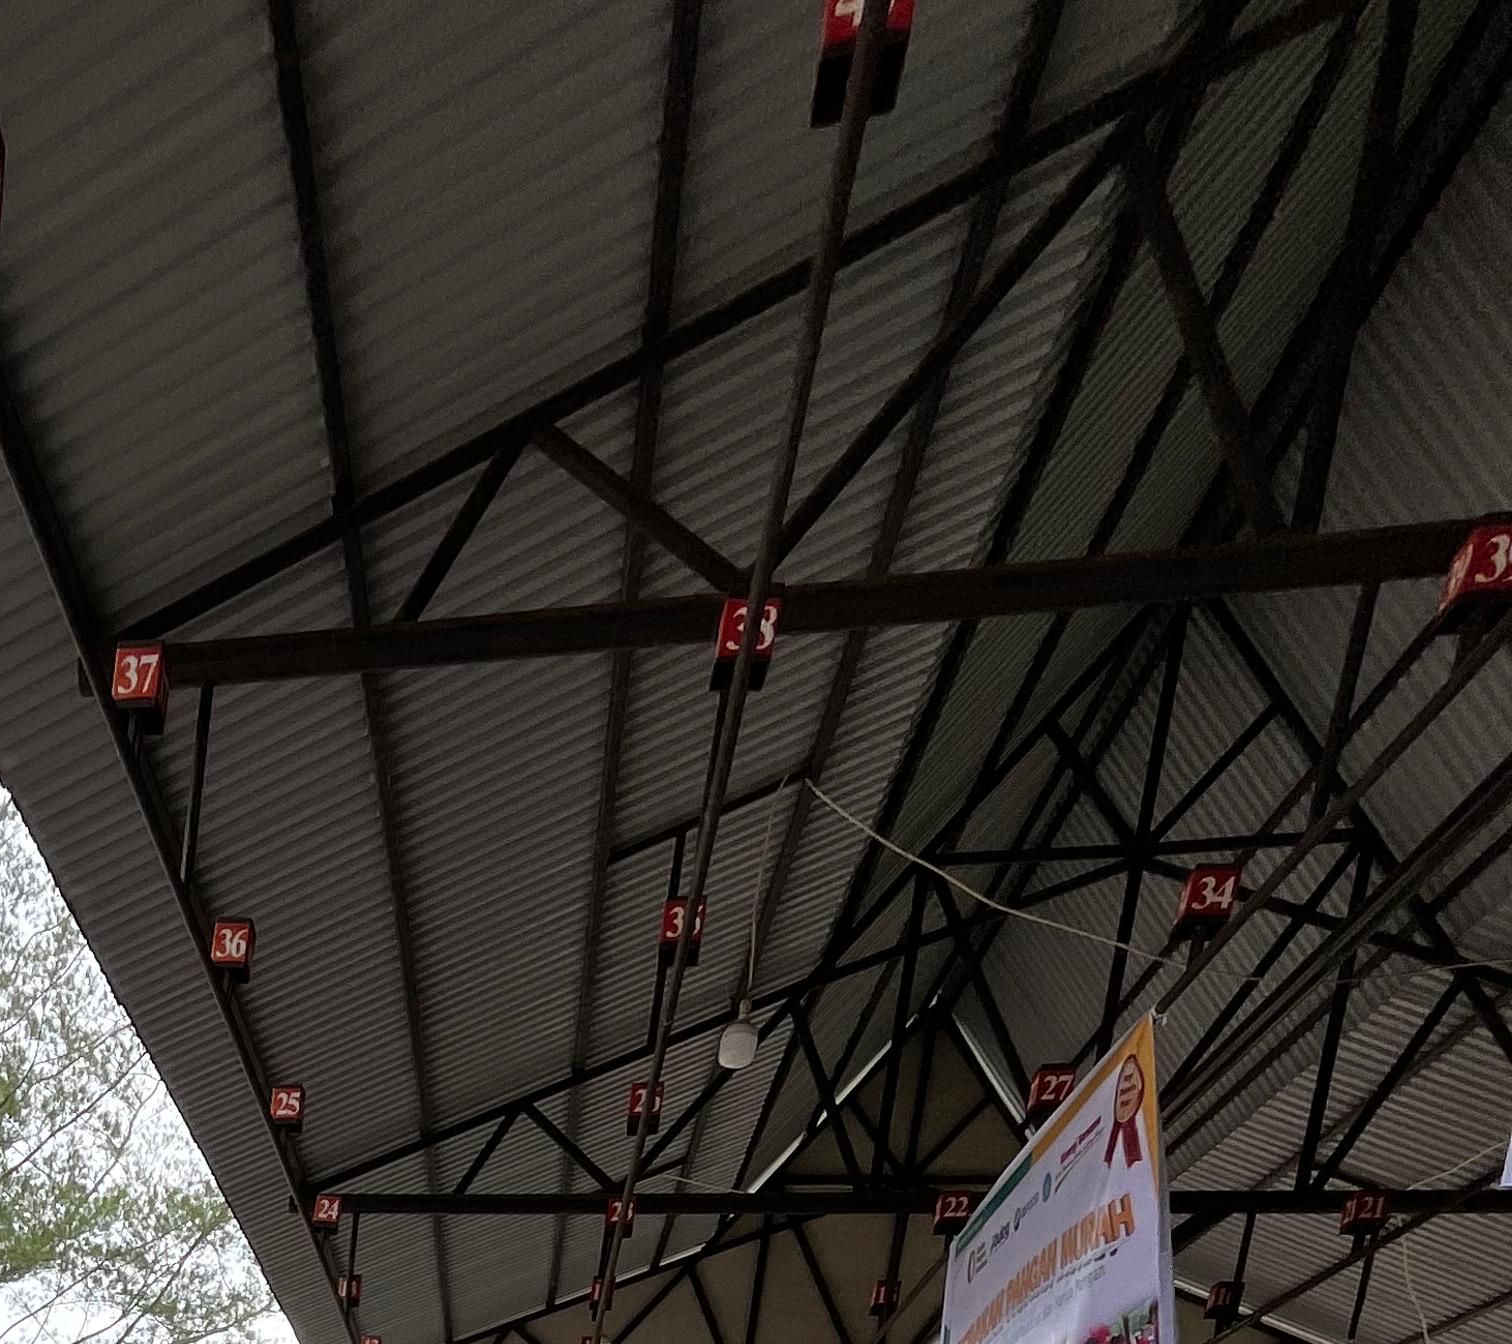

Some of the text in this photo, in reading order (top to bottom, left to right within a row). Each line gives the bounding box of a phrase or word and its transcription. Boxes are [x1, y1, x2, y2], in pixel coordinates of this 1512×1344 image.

[1474, 533, 1512, 583] 3
[117, 654, 159, 694] 37
[1191, 875, 1236, 910] 34
[215, 928, 249, 958] 36
[1041, 1074, 1074, 1101] 27
[276, 1092, 302, 1118] 25
[318, 1199, 341, 1219] 24
[943, 1196, 969, 1217] 22
[1360, 1196, 1386, 1219] 21
